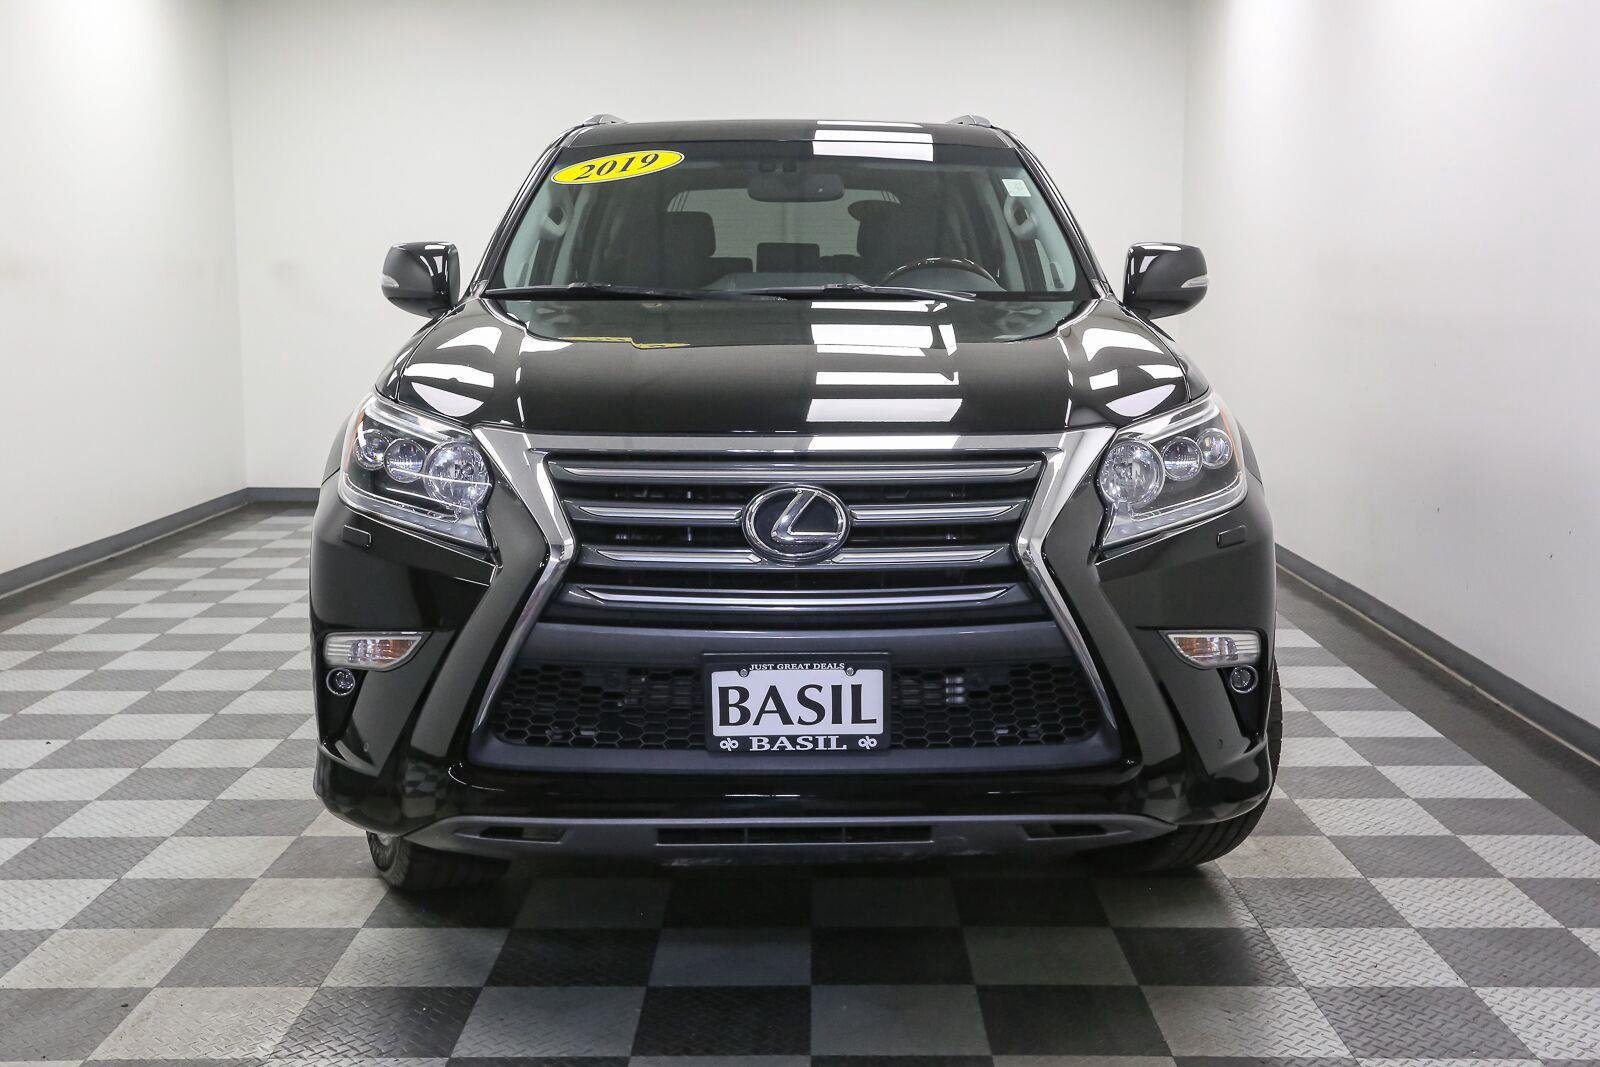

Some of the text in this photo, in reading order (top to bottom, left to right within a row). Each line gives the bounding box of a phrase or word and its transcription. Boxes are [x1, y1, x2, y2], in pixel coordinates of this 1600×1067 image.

[574, 153, 659, 181] 2019
[718, 684, 877, 726] BASIL
[749, 736, 847, 751] BASIL
